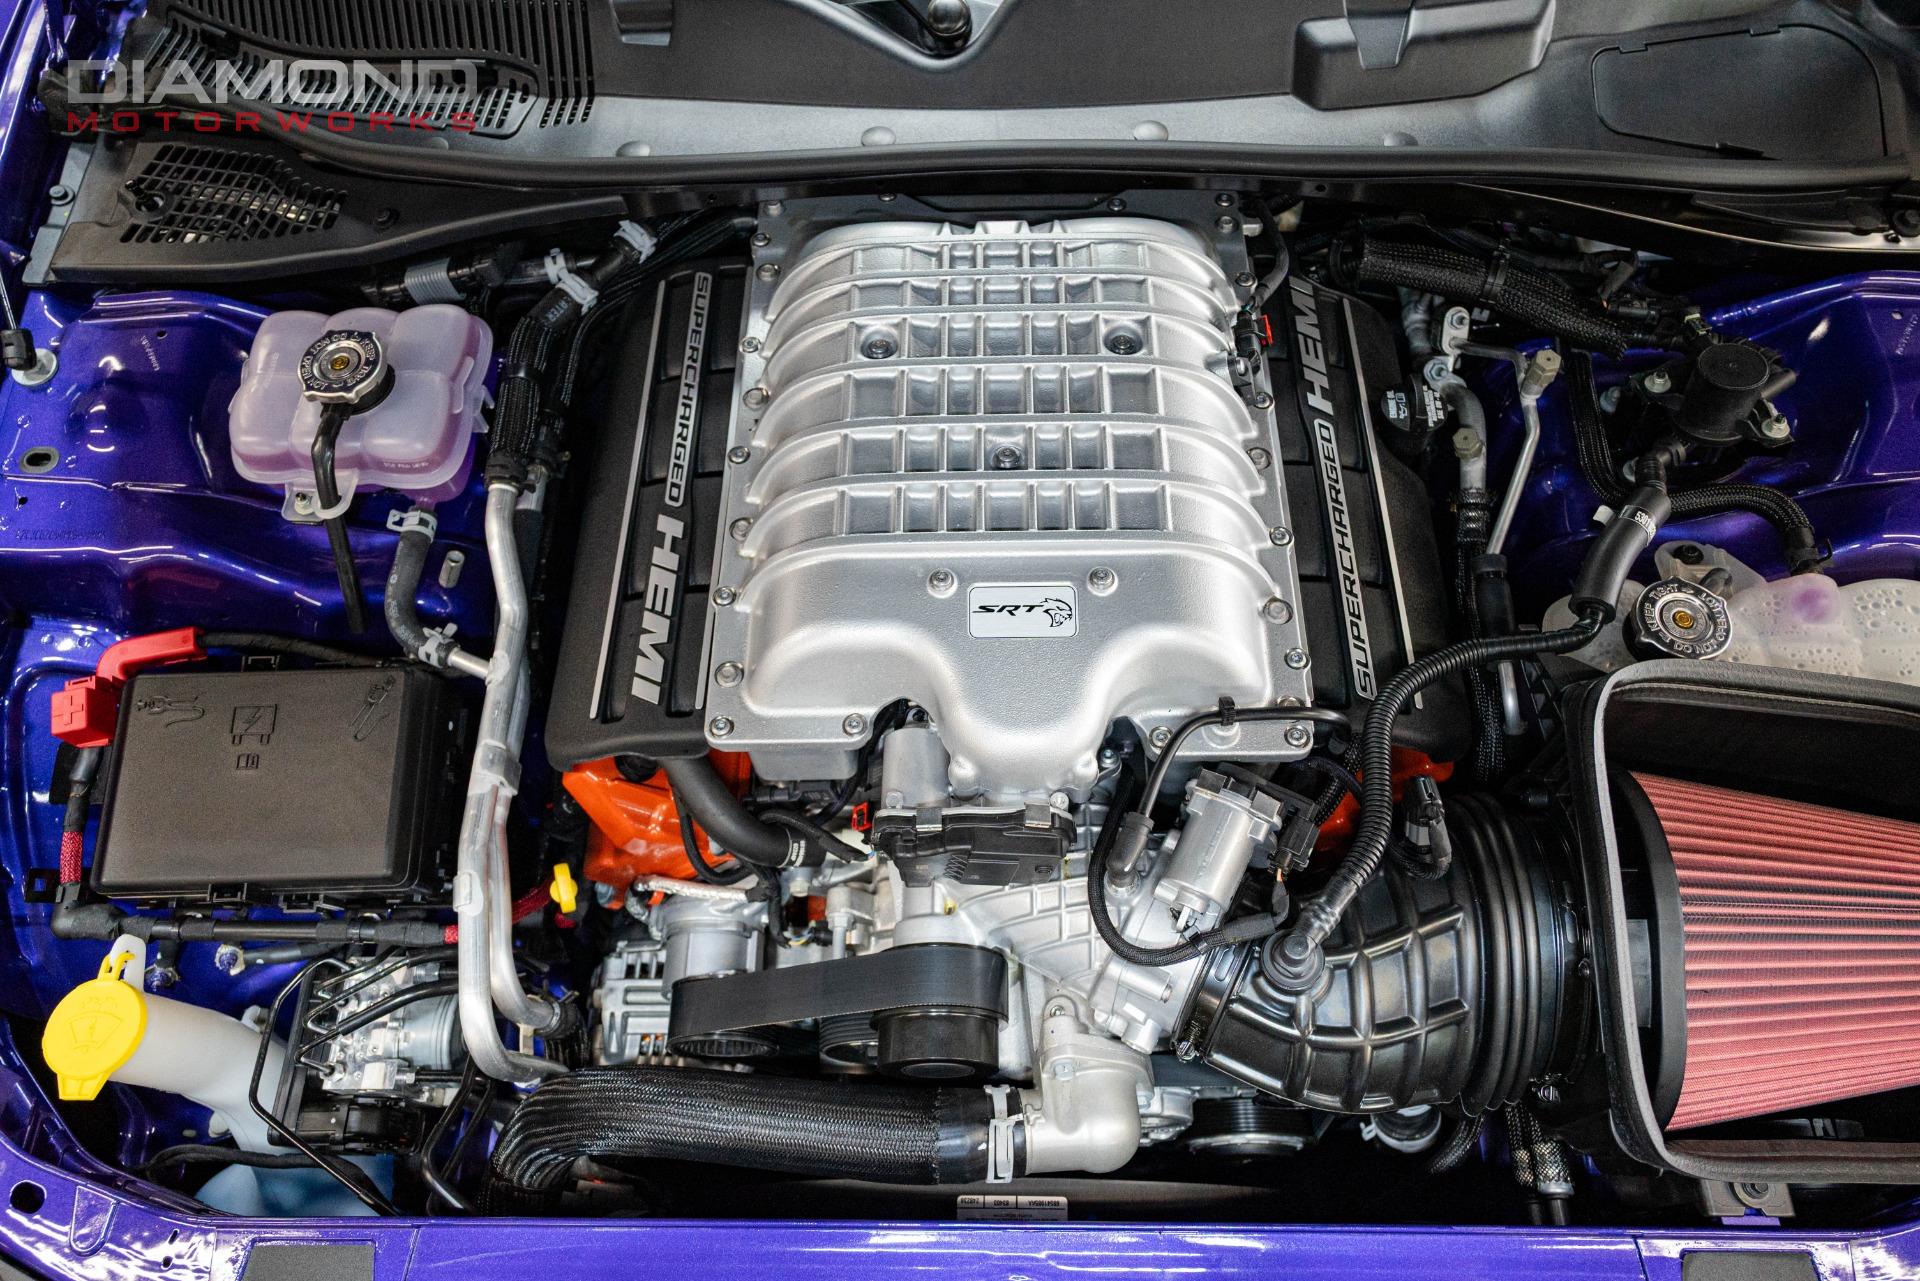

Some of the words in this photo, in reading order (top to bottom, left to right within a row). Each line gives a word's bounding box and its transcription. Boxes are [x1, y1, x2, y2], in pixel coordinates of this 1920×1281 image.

[668, 274, 710, 503] SUPERCHARGED
[1289, 275, 1334, 416] HEMI
[631, 514, 685, 705] HEMI
[972, 604, 1045, 616] SRT
[1318, 422, 1374, 697] SUPERCHARGED
